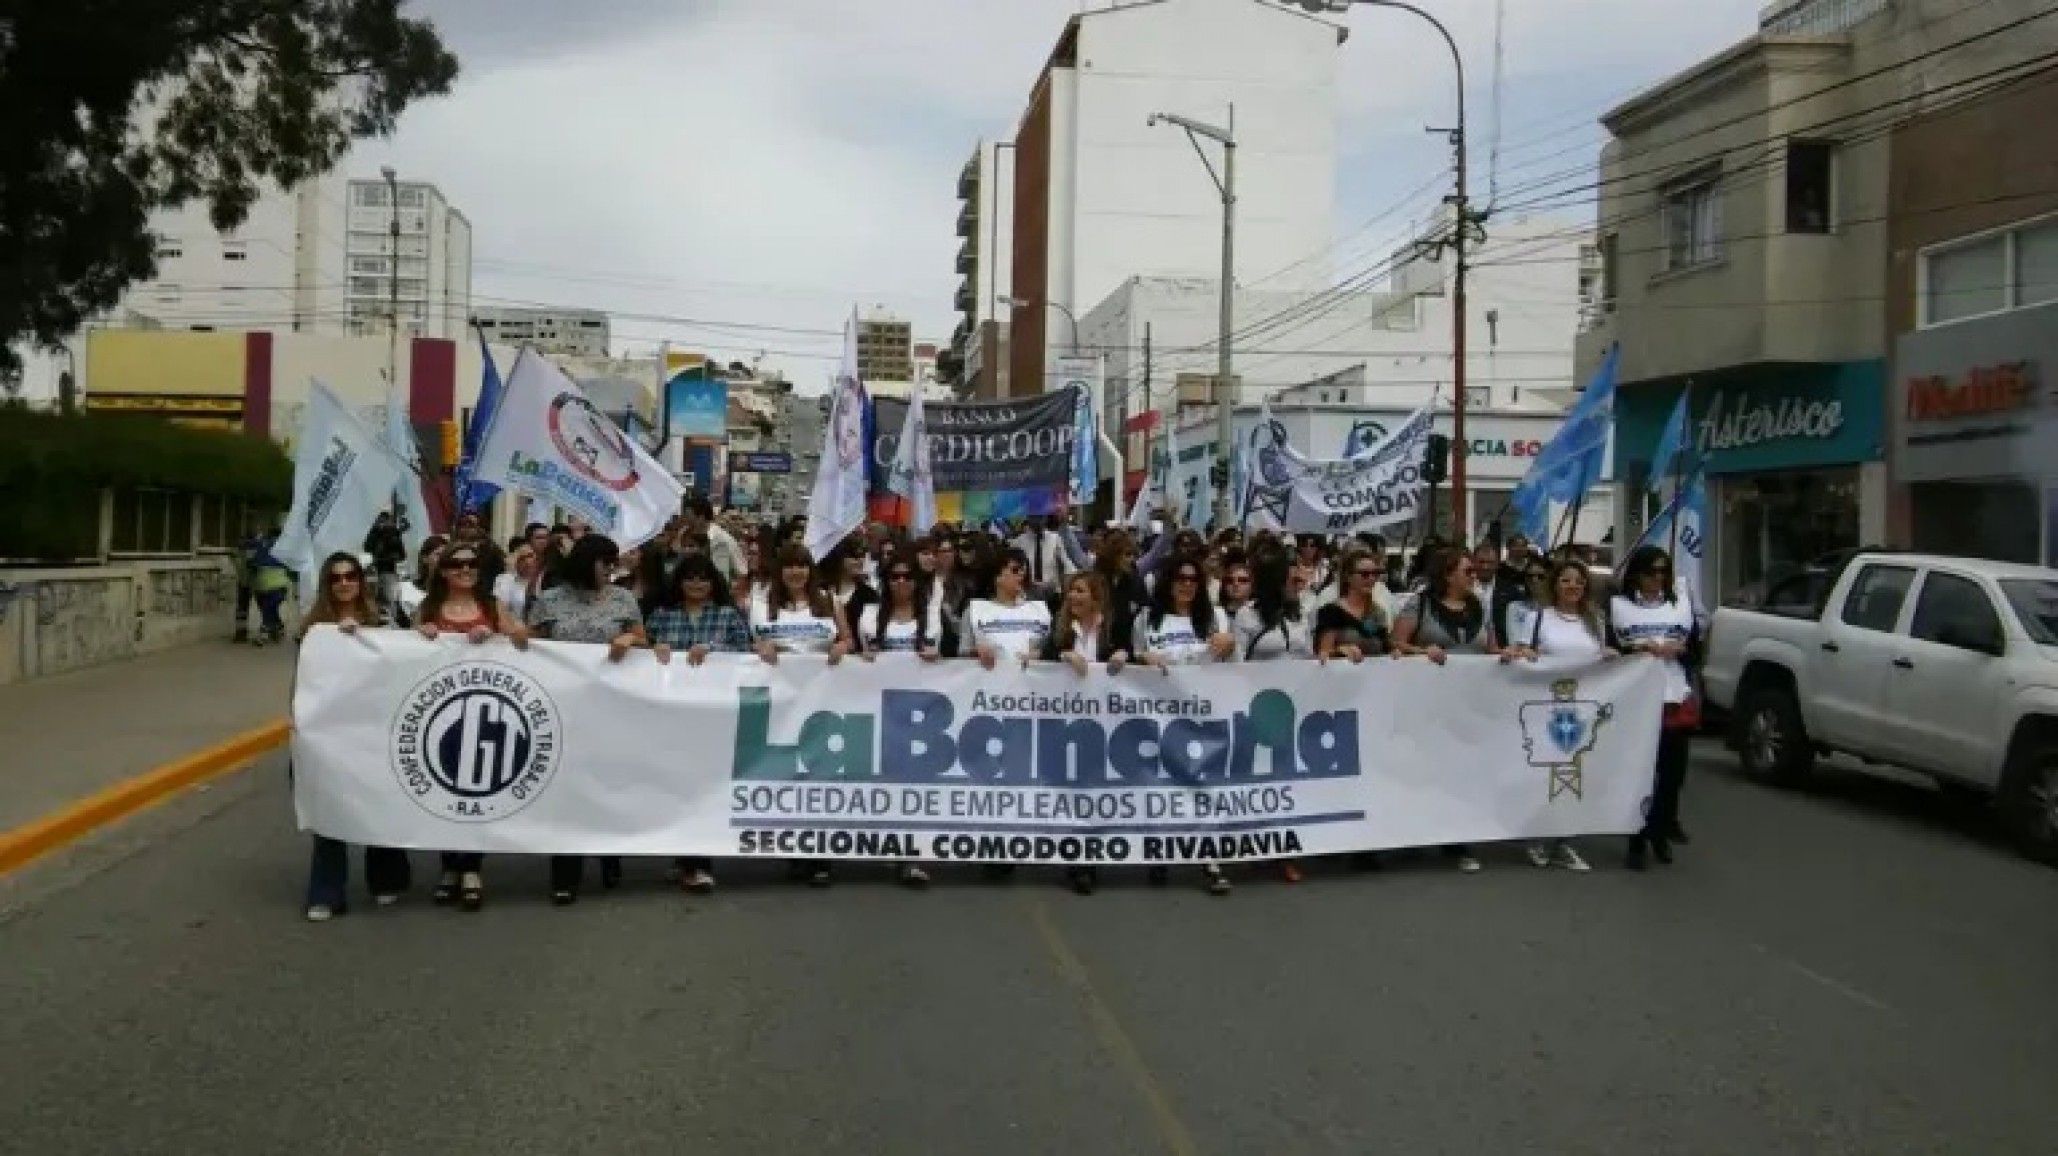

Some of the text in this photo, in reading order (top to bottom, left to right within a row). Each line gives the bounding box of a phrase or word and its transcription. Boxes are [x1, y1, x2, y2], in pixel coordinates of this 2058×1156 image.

[942, 407, 1017, 425] BANCO
[1699, 387, 1844, 450] Asterisco
[875, 423, 1073, 468] CEDICOOP
[459, 667, 529, 703] GENERAL
[972, 690, 1212, 715] Asociación Bancaria
[525, 697, 550, 730] DEL
[427, 694, 529, 792] CGT
[511, 731, 553, 800] TRABAJO
[731, 785, 1295, 819] SOCIEDAD DE EMPLEADOS DE BANCOS
[739, 830, 1303, 860] SECCIONAL COMODORO RIVADAVIA
